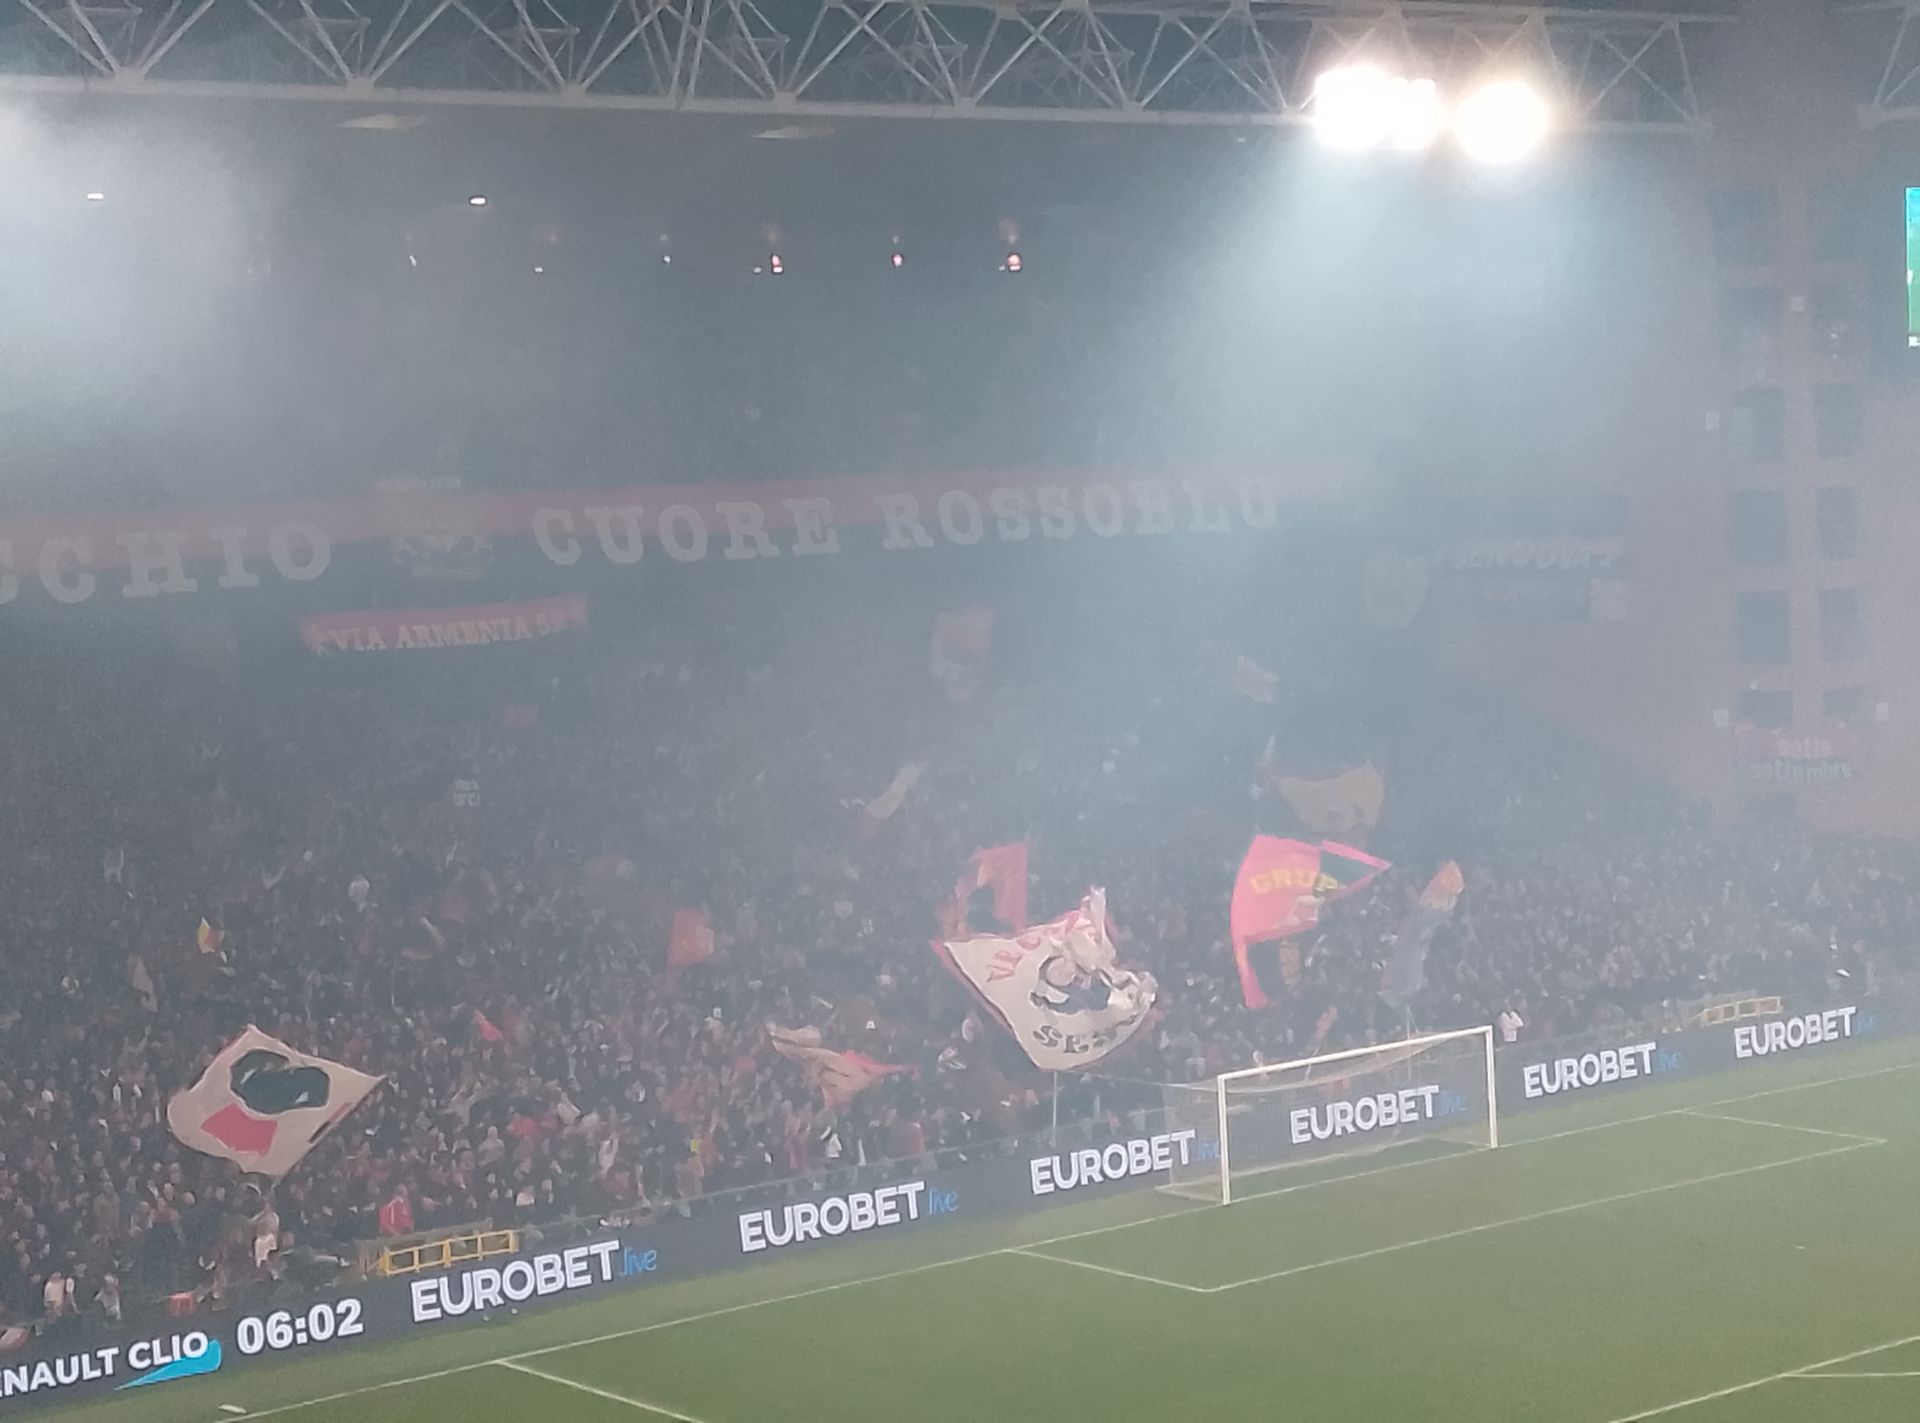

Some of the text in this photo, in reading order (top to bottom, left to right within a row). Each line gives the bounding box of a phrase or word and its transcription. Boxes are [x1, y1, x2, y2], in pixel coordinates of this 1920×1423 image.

[532, 497, 840, 565] CUORE
[873, 475, 1277, 548] ROSSOBLU
[396, 616, 532, 649] ARMENIA
[1734, 1006, 1856, 1058] EUROBET
[1523, 1042, 1656, 1098] EUROBET
[1290, 1085, 1439, 1144] EUROBET
[1030, 1129, 1195, 1195] EUROBET
[739, 1181, 925, 1252] EUROBET
[411, 1239, 657, 1322] EUROBET live
[237, 1298, 364, 1354] 06:02
[0, 1332, 208, 1397] NAULT CLIO
